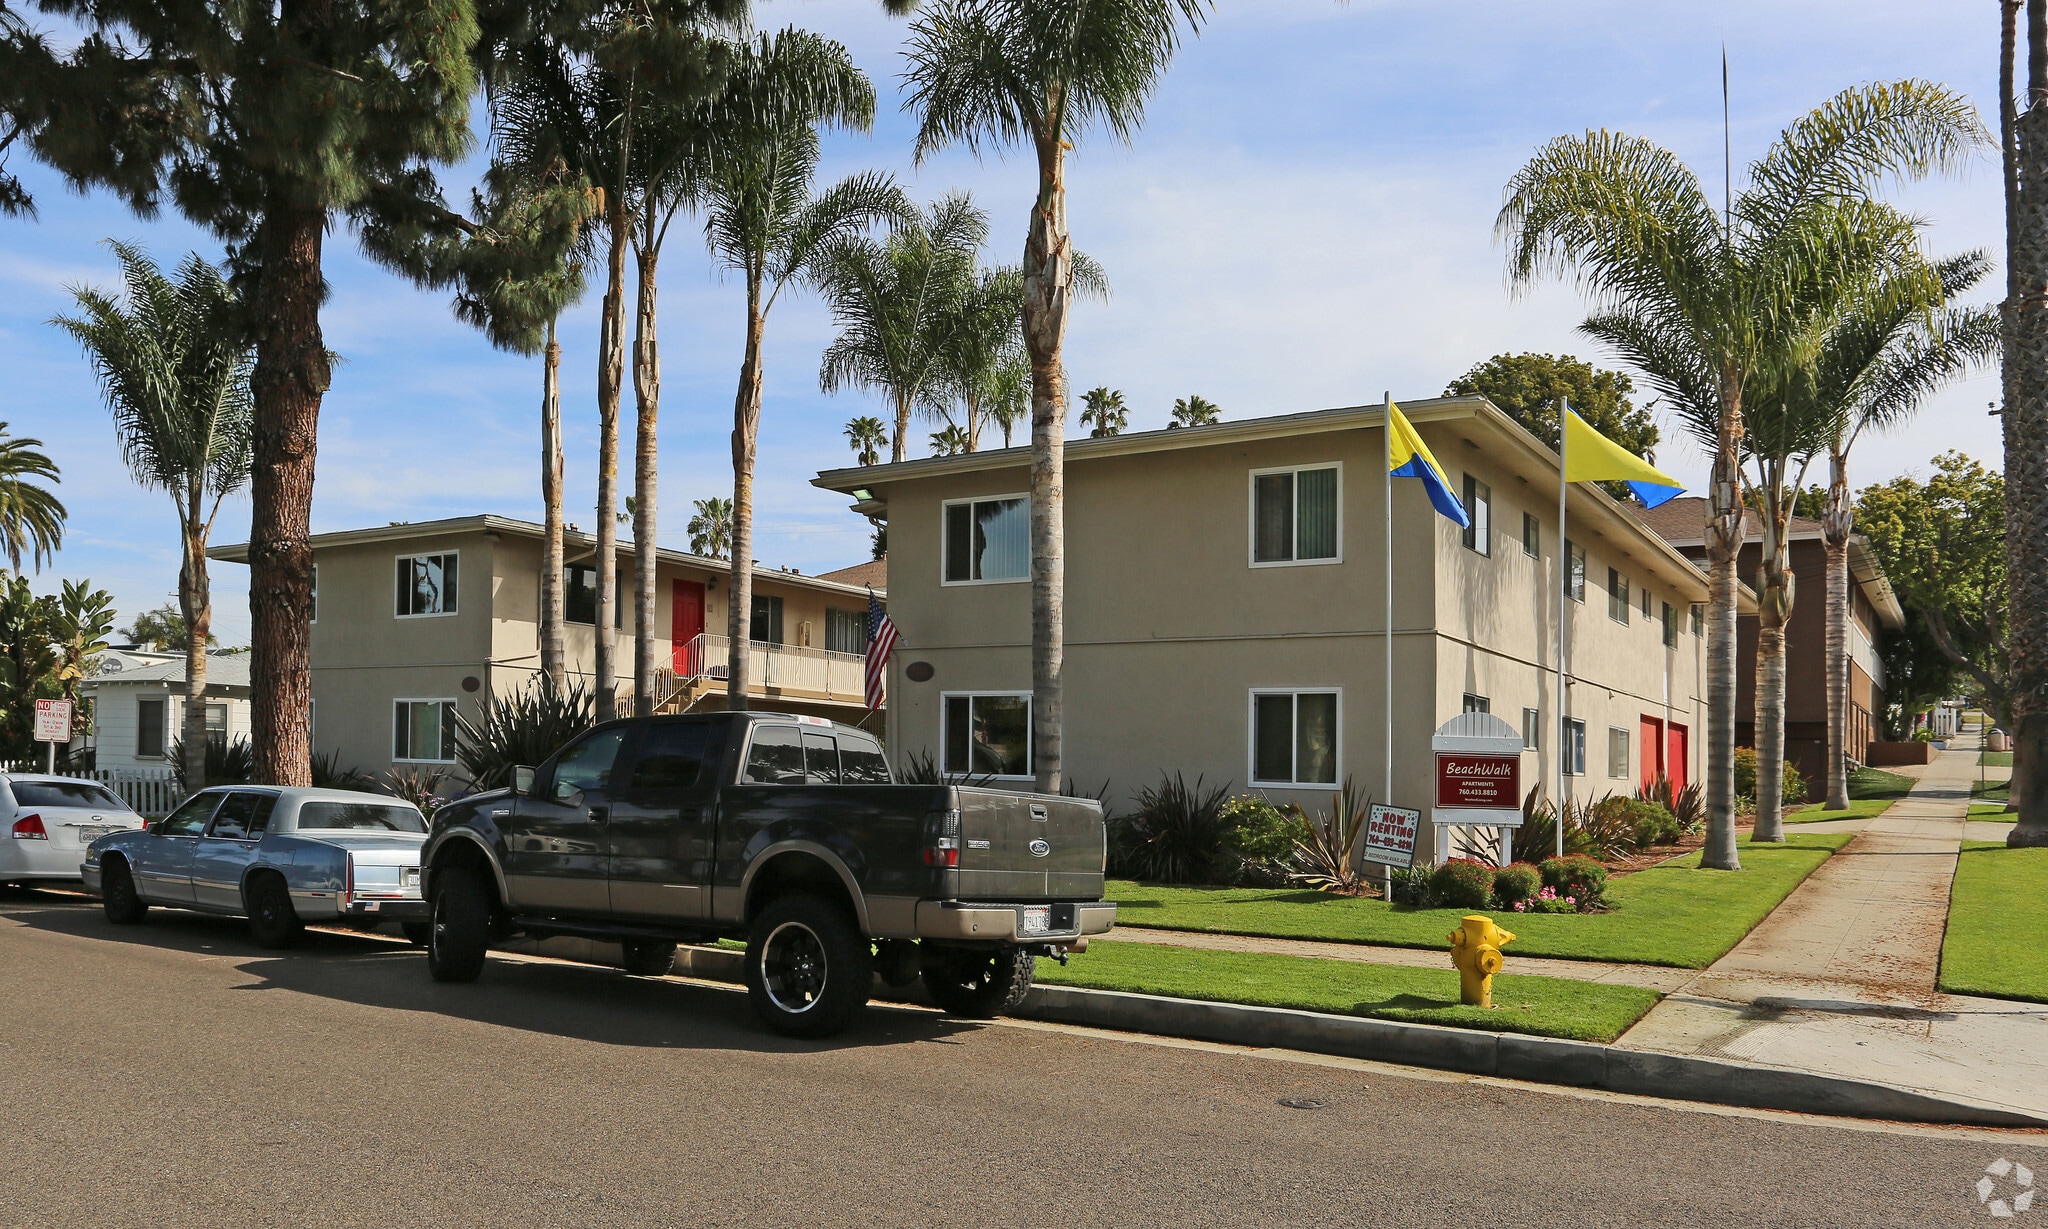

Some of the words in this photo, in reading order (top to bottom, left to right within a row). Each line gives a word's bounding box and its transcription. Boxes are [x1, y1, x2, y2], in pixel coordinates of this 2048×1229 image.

[38, 701, 50, 710] NO
[40, 711, 67, 719] PARKING
[1446, 762, 1512, 776] BeachWalk
[1459, 788, 1498, 796] 760.433.8810
[1382, 812, 1406, 826] NOW
[1371, 821, 1414, 839] RENTING
[1368, 852, 1390, 861] BEDROOM
